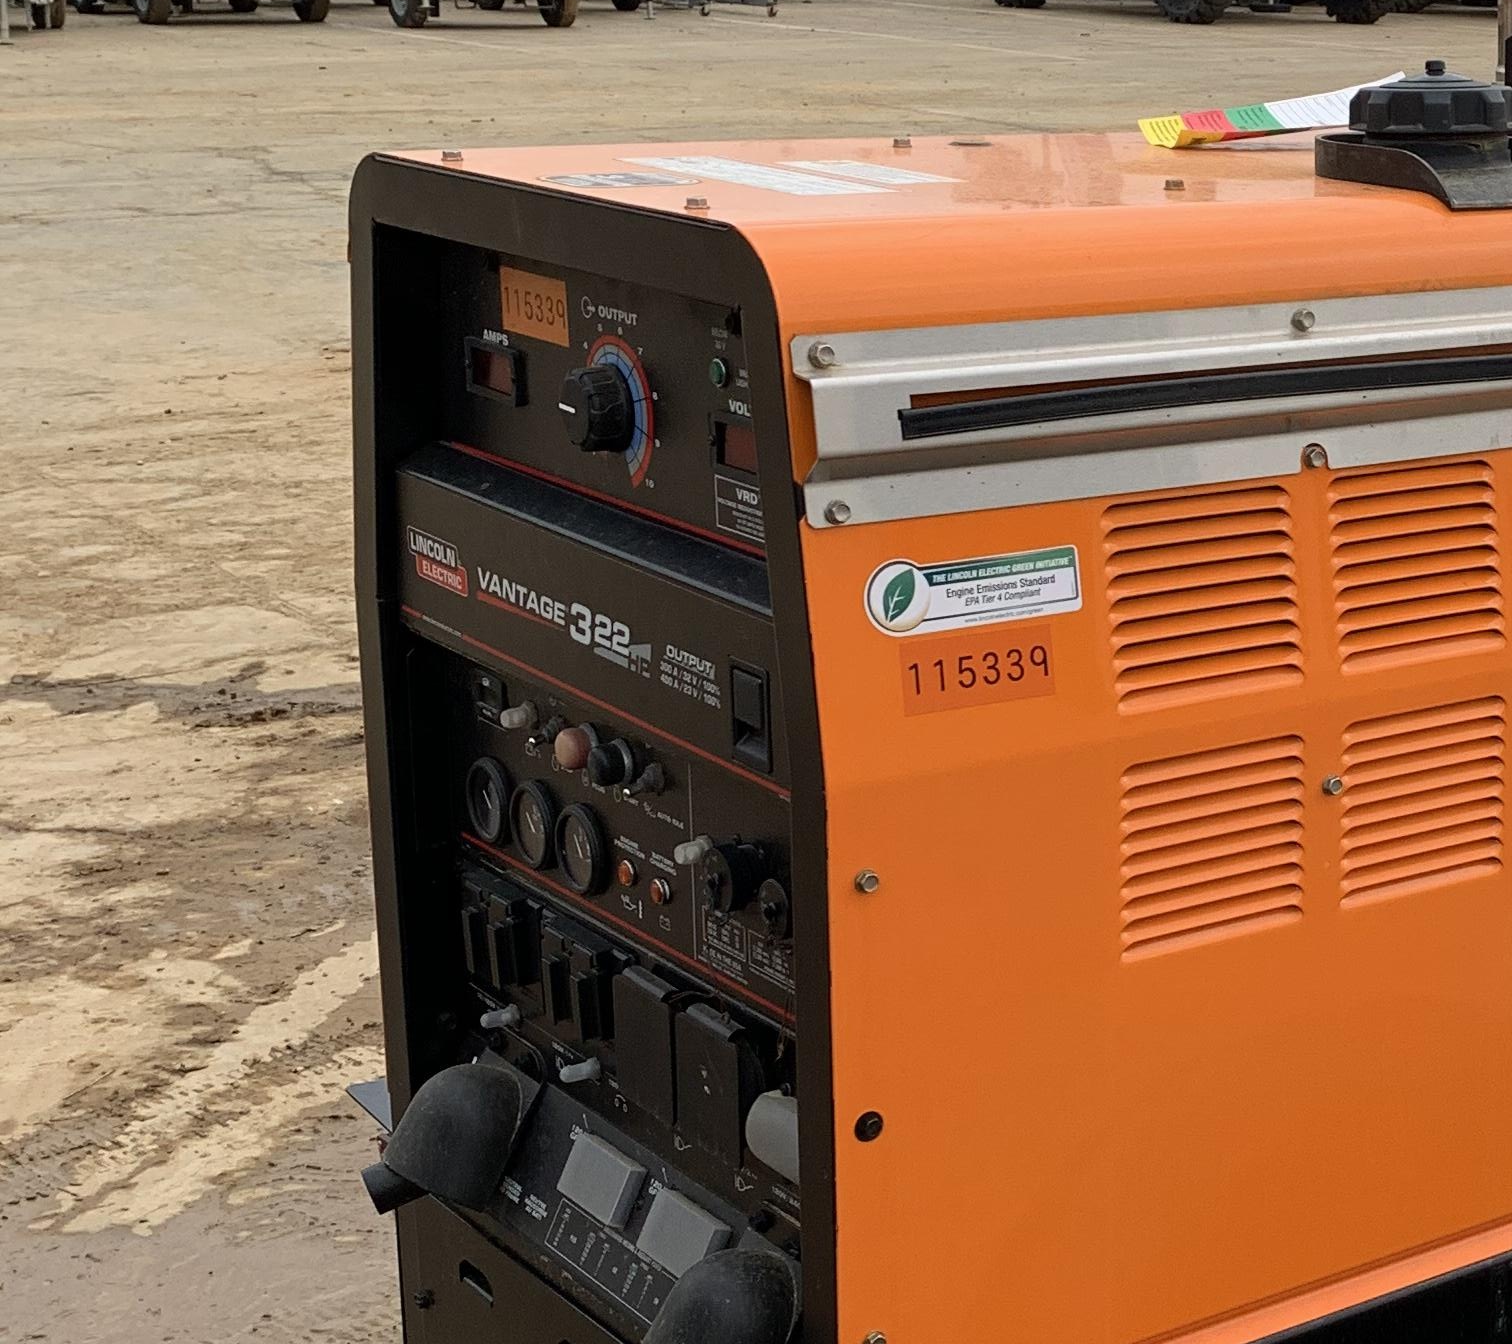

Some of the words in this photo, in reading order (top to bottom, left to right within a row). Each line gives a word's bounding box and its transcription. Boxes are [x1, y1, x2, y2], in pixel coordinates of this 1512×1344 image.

[503, 286, 566, 330] 115339
[598, 305, 638, 326] OUTPUT
[483, 328, 509, 347] AMPS
[736, 488, 758, 505] VRD
[410, 531, 456, 567] LINCOLN
[422, 560, 463, 591] ELECTRIC
[933, 574, 946, 582] THE
[947, 569, 977, 581] LINCOLN
[979, 564, 1011, 576] ELECTRIC
[1012, 561, 1034, 572] GREEN
[946, 586, 974, 599] Engine
[976, 580, 1018, 594] Emissions
[1020, 574, 1056, 588] Standard
[965, 596, 979, 606] EPA
[982, 593, 995, 604] Tier
[1004, 588, 1042, 602] Compliant
[569, 602, 631, 656] 322
[666, 644, 712, 674] OUTPUT
[908, 644, 1049, 695] 115339
